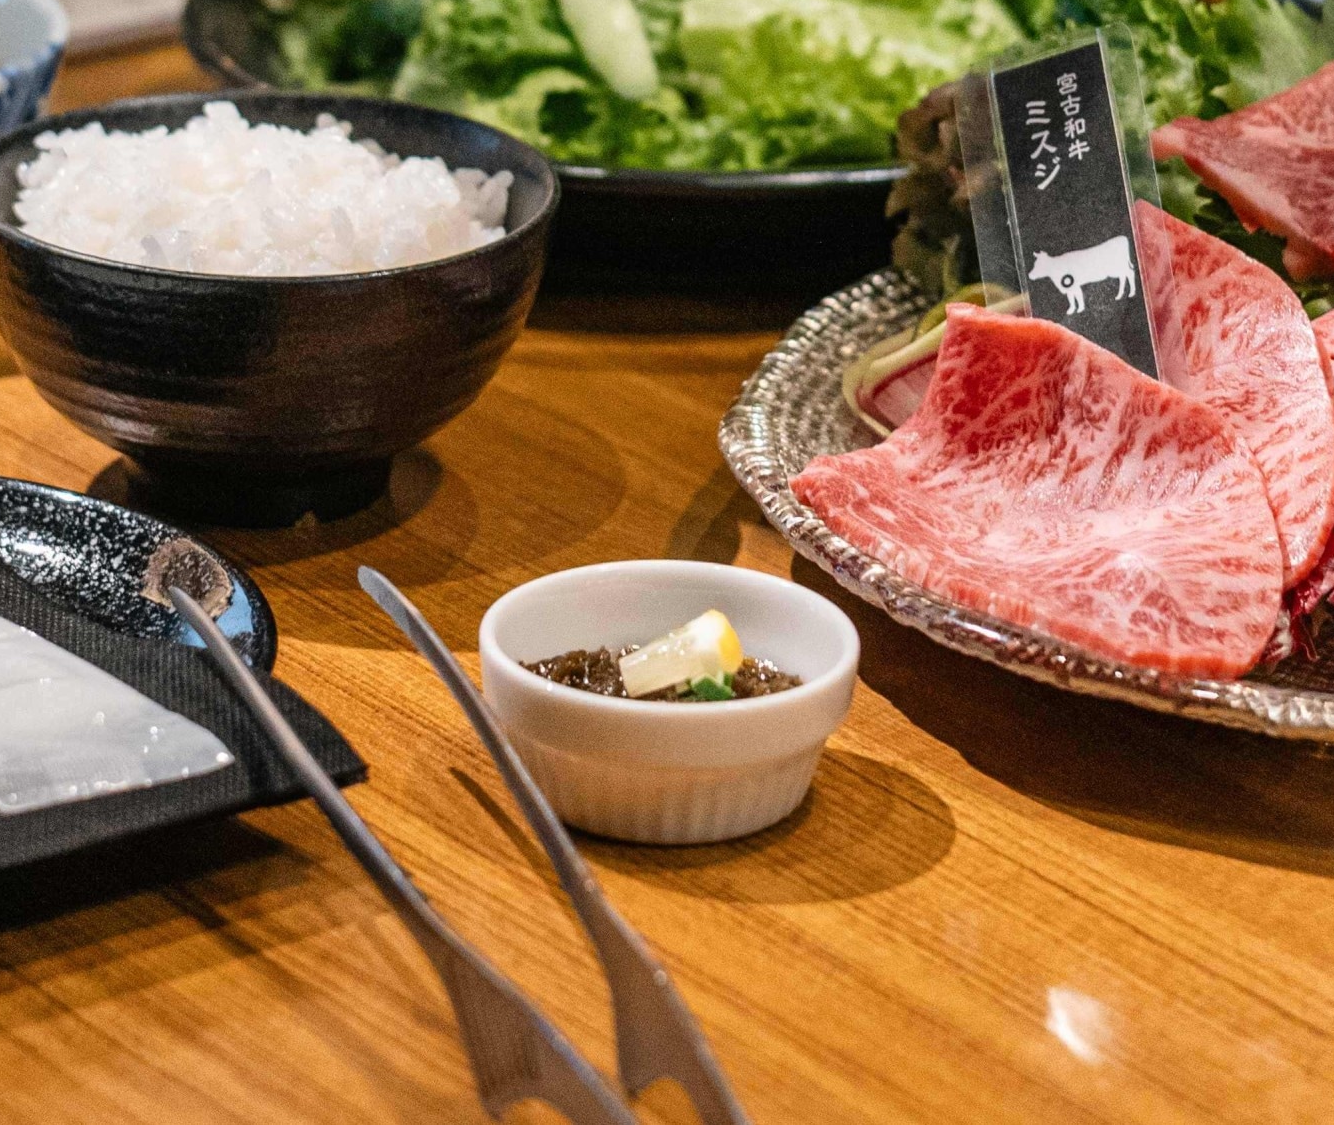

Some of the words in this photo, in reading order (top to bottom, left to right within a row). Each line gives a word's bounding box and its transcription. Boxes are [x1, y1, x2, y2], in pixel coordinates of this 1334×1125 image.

[1025, 100, 1061, 191] ミスジ
[1056, 73, 1091, 161] 宮古和牛
